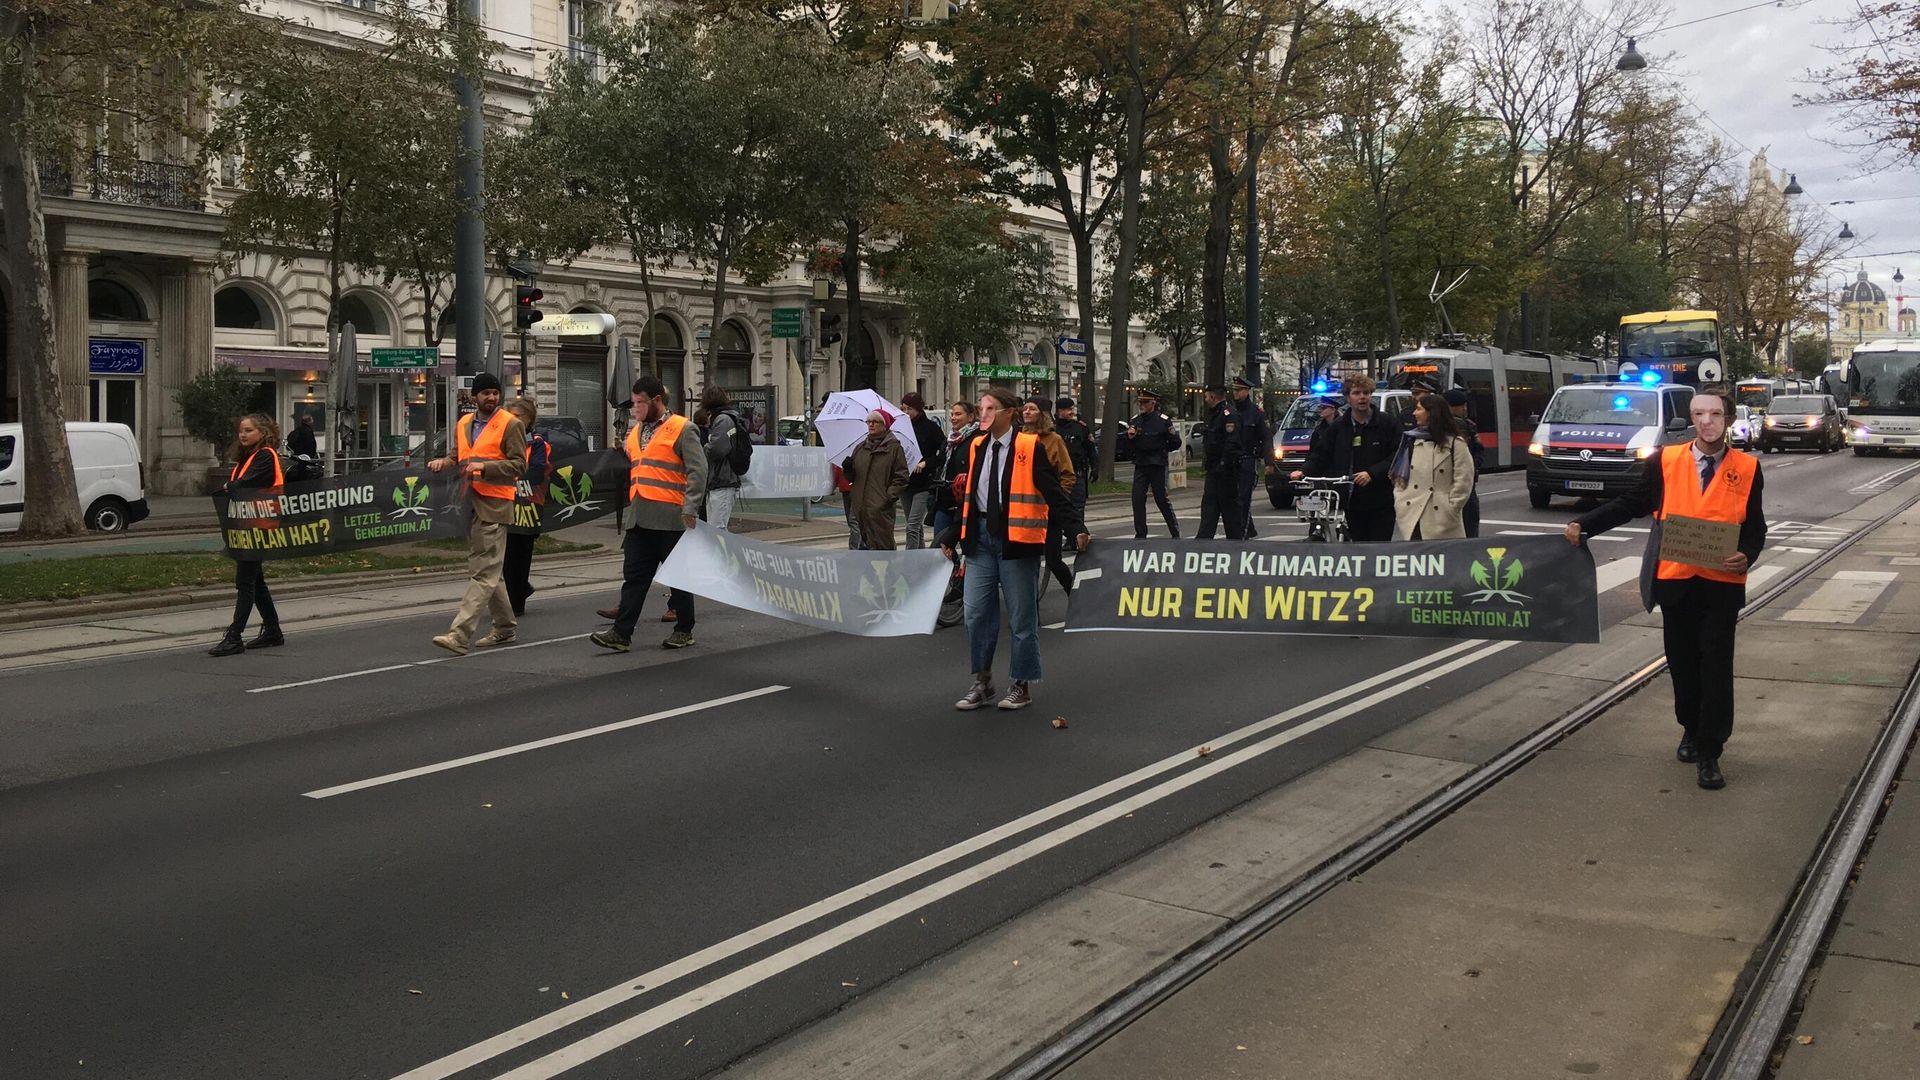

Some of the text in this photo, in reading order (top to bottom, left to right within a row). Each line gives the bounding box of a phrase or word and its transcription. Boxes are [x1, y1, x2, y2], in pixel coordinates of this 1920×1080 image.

[90, 344, 140, 358] Fayrooz
[727, 391, 766, 401] ALBERTINA
[739, 400, 766, 408] modern
[1560, 430, 1622, 438] POLIZEI
[256, 499, 277, 518] DIE
[278, 484, 374, 516] REGIERUNG
[344, 512, 382, 528] LETZTE
[253, 526, 288, 549] PLAN
[288, 518, 331, 546] HAT?
[355, 518, 433, 541] GENERATION.AT
[1122, 549, 1445, 577] WAR DER KLIMARAT DENN
[1118, 586, 1374, 622] NUR EIN WITZ?
[1396, 590, 1453, 605] LETZTE
[1411, 607, 1531, 628] GENERATION.AT
